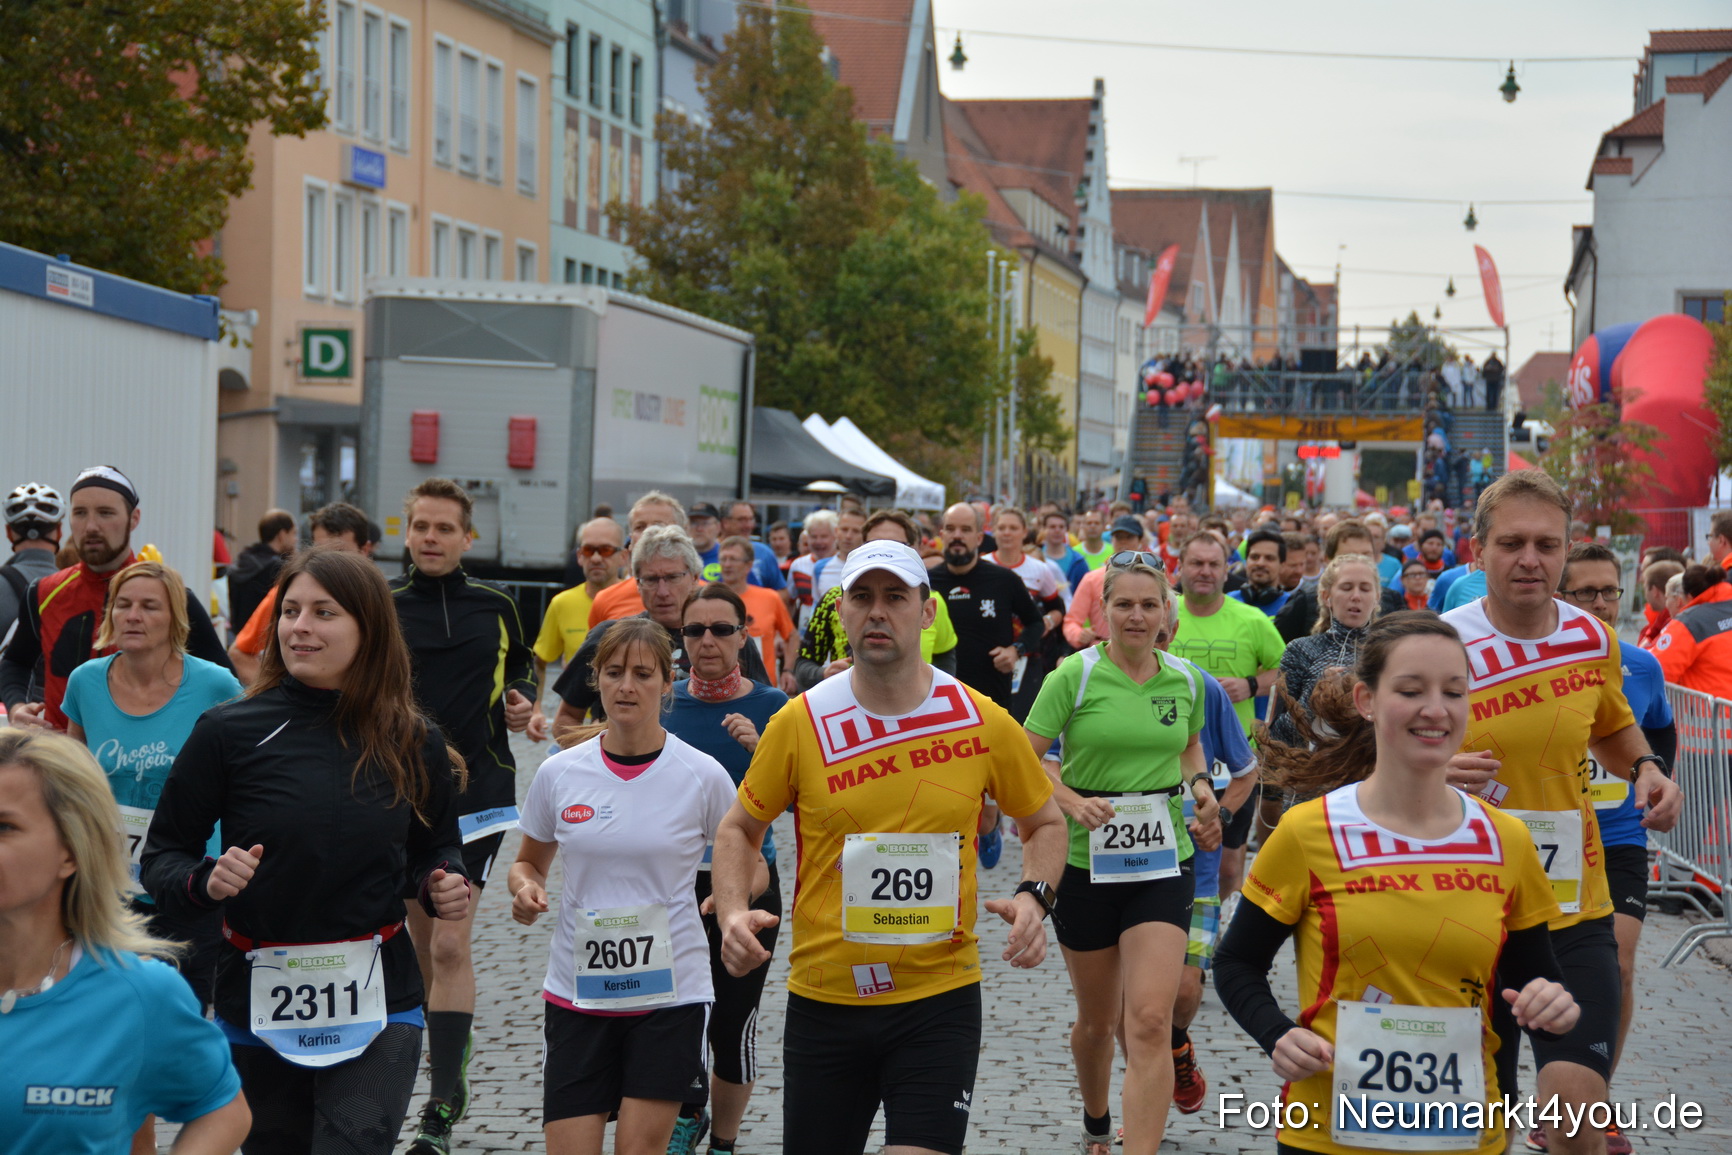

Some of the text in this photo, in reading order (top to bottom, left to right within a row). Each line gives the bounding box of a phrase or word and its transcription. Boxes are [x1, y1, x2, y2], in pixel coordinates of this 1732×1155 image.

[309, 334, 346, 373] D
[1471, 683, 1545, 722] MAX
[94, 738, 168, 776] Choose
[135, 752, 176, 782] your
[826, 736, 990, 794] MAX BÖGL
[564, 808, 592, 819] Hervis
[1123, 803, 1152, 813] BOCK
[1103, 820, 1166, 849] 2344
[888, 843, 929, 854] BOCK
[1124, 857, 1149, 867] Heike
[871, 867, 934, 901] 269
[1345, 867, 1506, 895] MAX BÖGL
[603, 915, 639, 927] BOCK
[873, 912, 930, 925] Sebastian
[300, 954, 346, 968] BOCK
[585, 934, 655, 970] 2607
[604, 978, 641, 991] Kerstin
[270, 979, 359, 1022] 2311
[1396, 1018, 1446, 1033] BOCK
[298, 1032, 341, 1048] Karina
[1357, 1047, 1464, 1095] 2634
[25, 1085, 116, 1107] BOCK
